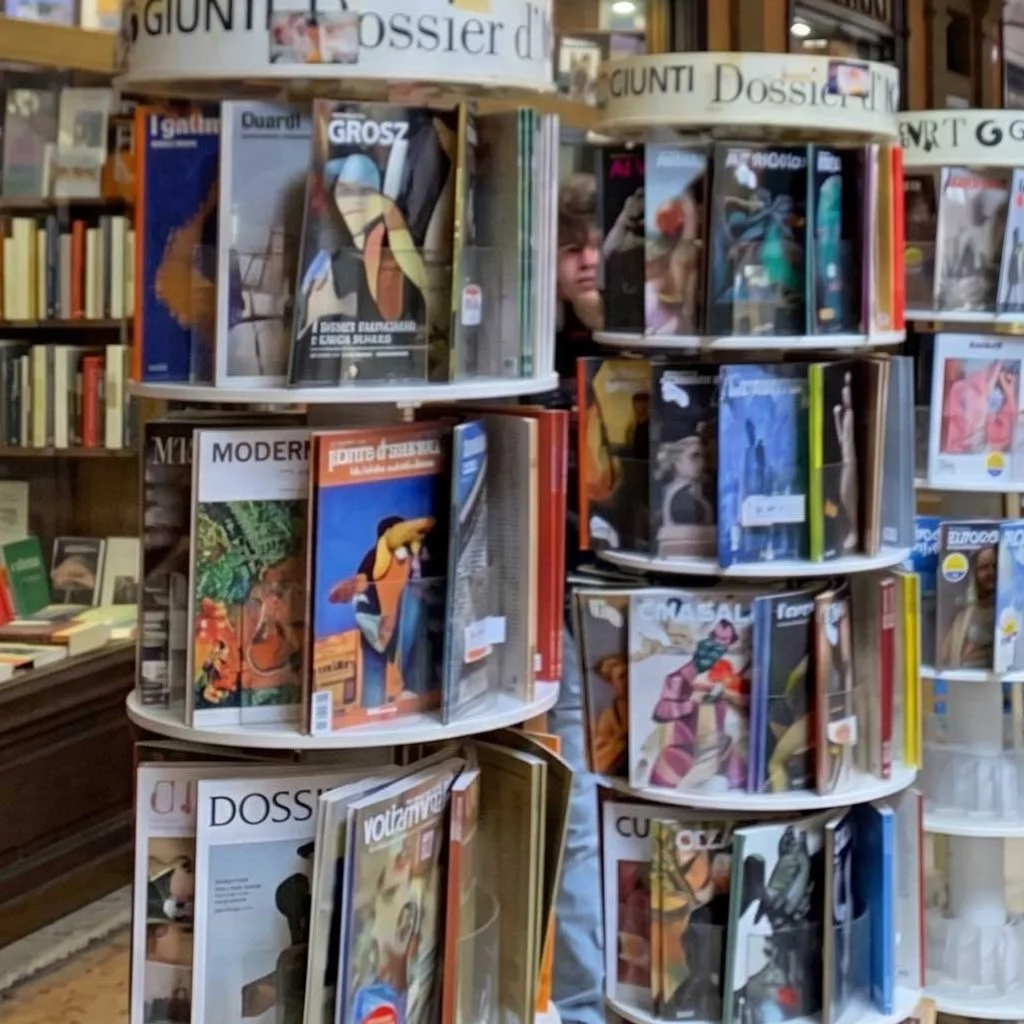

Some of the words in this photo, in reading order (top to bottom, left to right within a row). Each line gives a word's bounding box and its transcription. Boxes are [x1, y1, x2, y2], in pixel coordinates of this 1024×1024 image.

[609, 64, 694, 98] GIUNTI
[328, 119, 410, 146] GROSZ
[209, 787, 332, 827] DOSS
